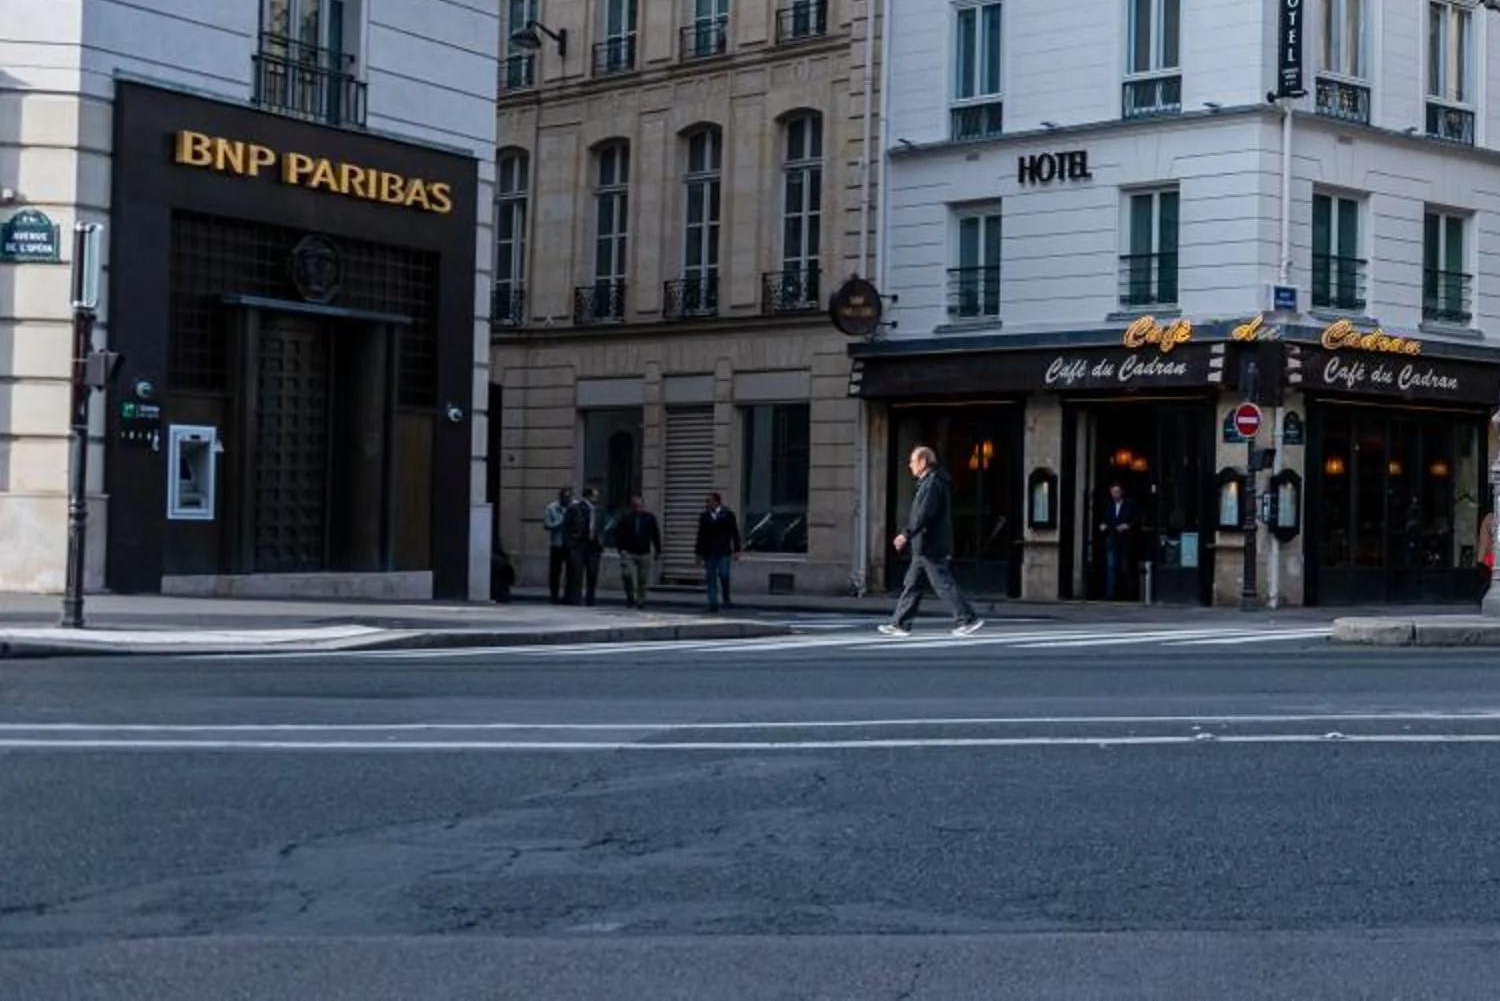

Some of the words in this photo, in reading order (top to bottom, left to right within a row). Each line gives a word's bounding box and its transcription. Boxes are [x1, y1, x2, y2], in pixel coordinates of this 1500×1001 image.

[175, 130, 276, 177] BNP
[281, 151, 452, 215] PARIBAS
[1018, 150, 1093, 185] HOTEL
[1123, 315, 1192, 353] Café
[1045, 356, 1086, 385] Café
[1091, 358, 1114, 377] du
[1117, 355, 1187, 383] Cadran
[1323, 356, 1365, 388] Café
[1371, 364, 1393, 384] du
[1398, 364, 1459, 390] Cadran
